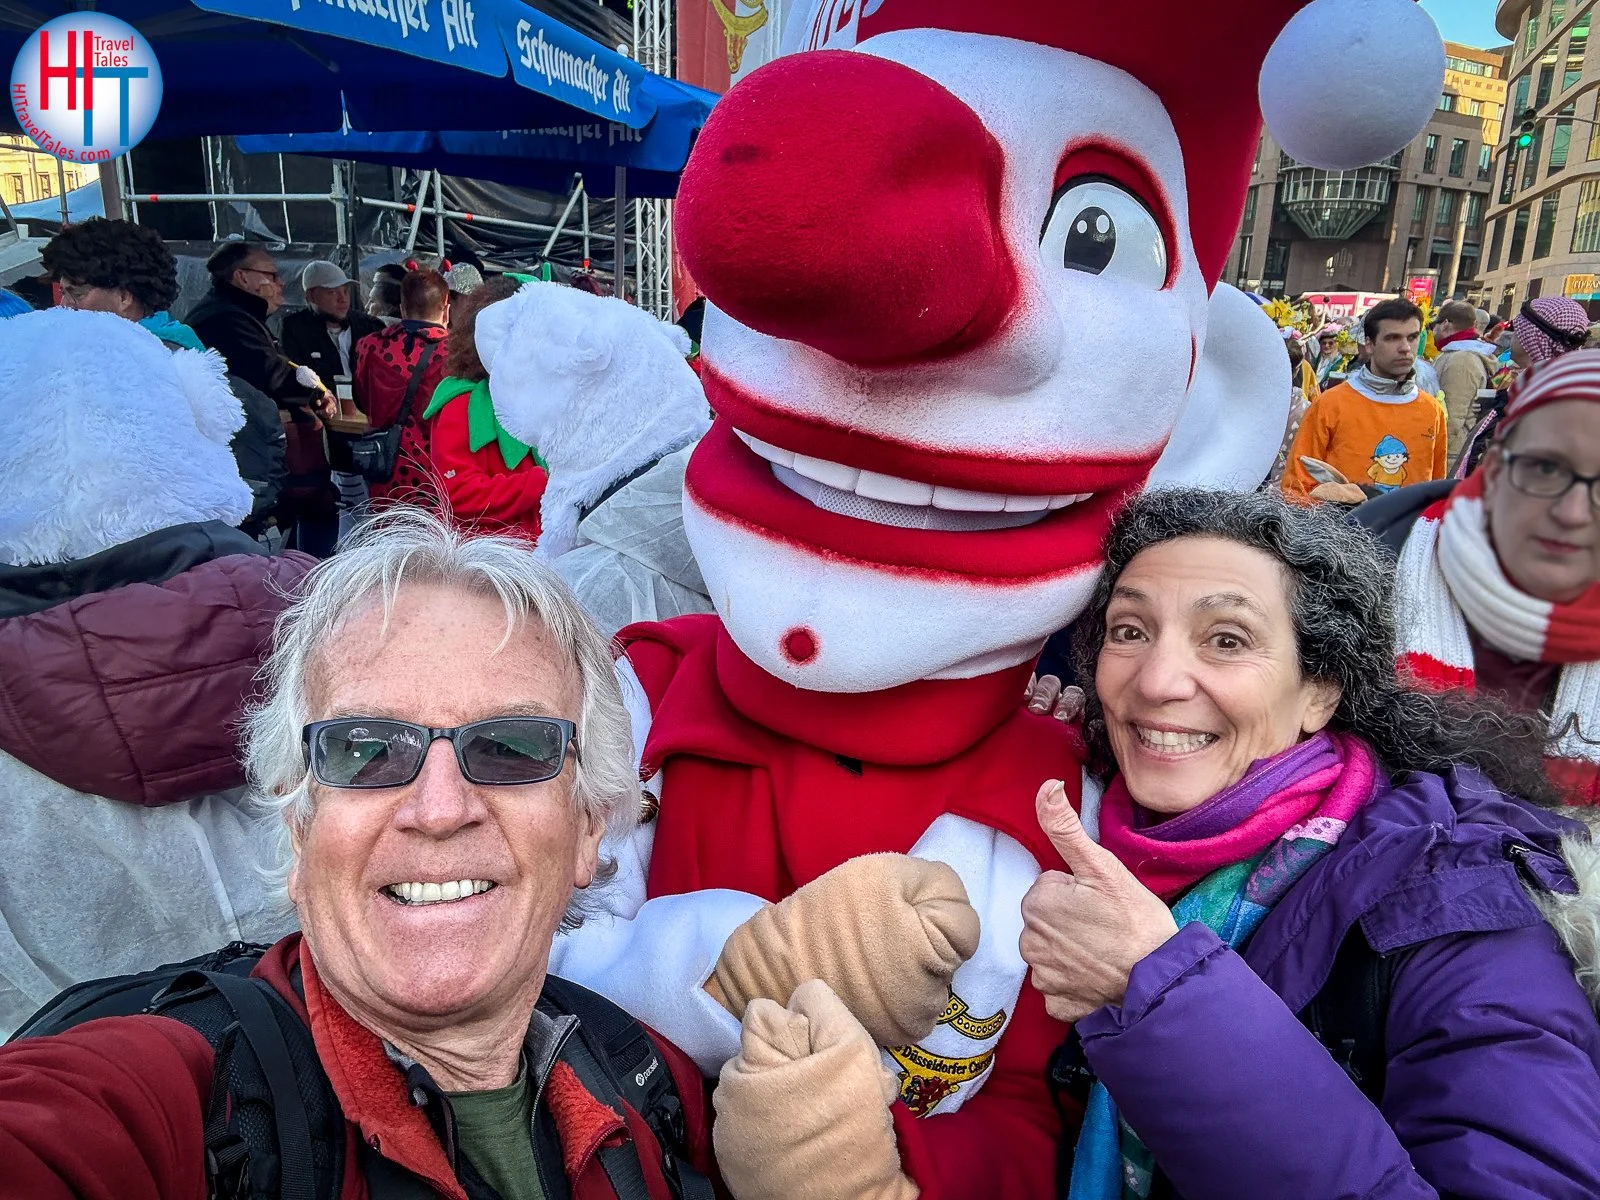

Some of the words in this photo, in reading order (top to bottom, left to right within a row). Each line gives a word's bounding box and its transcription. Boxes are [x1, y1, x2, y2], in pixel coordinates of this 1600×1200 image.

[516, 18, 609, 105] Schumacher
[613, 68, 631, 114] Alt
[901, 1045, 967, 1074] Düsseldorfer
